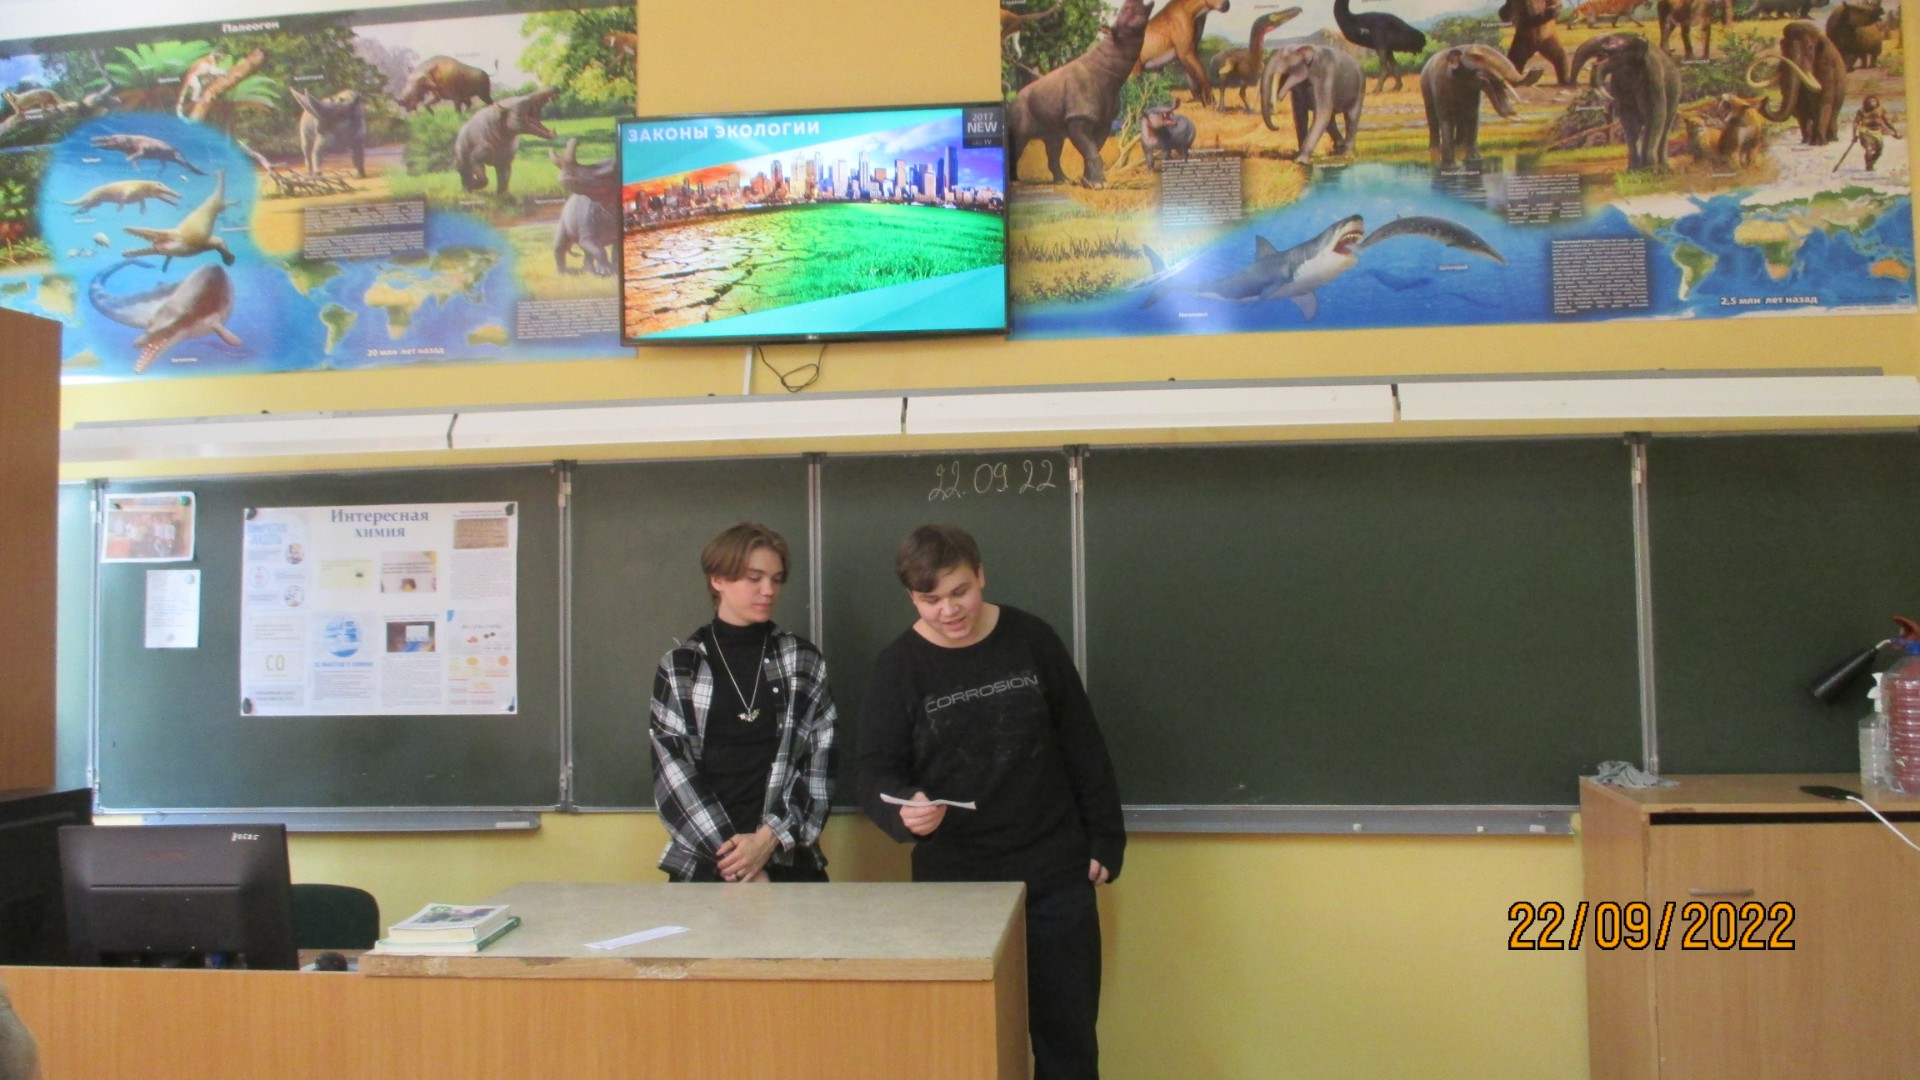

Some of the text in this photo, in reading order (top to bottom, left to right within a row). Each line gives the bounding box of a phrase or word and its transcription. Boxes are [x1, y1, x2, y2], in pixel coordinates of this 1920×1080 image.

[222, 21, 280, 33] Палеоген
[972, 112, 994, 121] 2017
[628, 121, 820, 142] ЗАКОНЫ ЭКОЛОГИИ
[967, 121, 998, 133] NEW
[1720, 297, 1737, 305] 2,5
[1785, 296, 1818, 305] назад
[330, 509, 429, 526] Интересная
[355, 528, 406, 538] химия
[925, 675, 1039, 713] CORROSION
